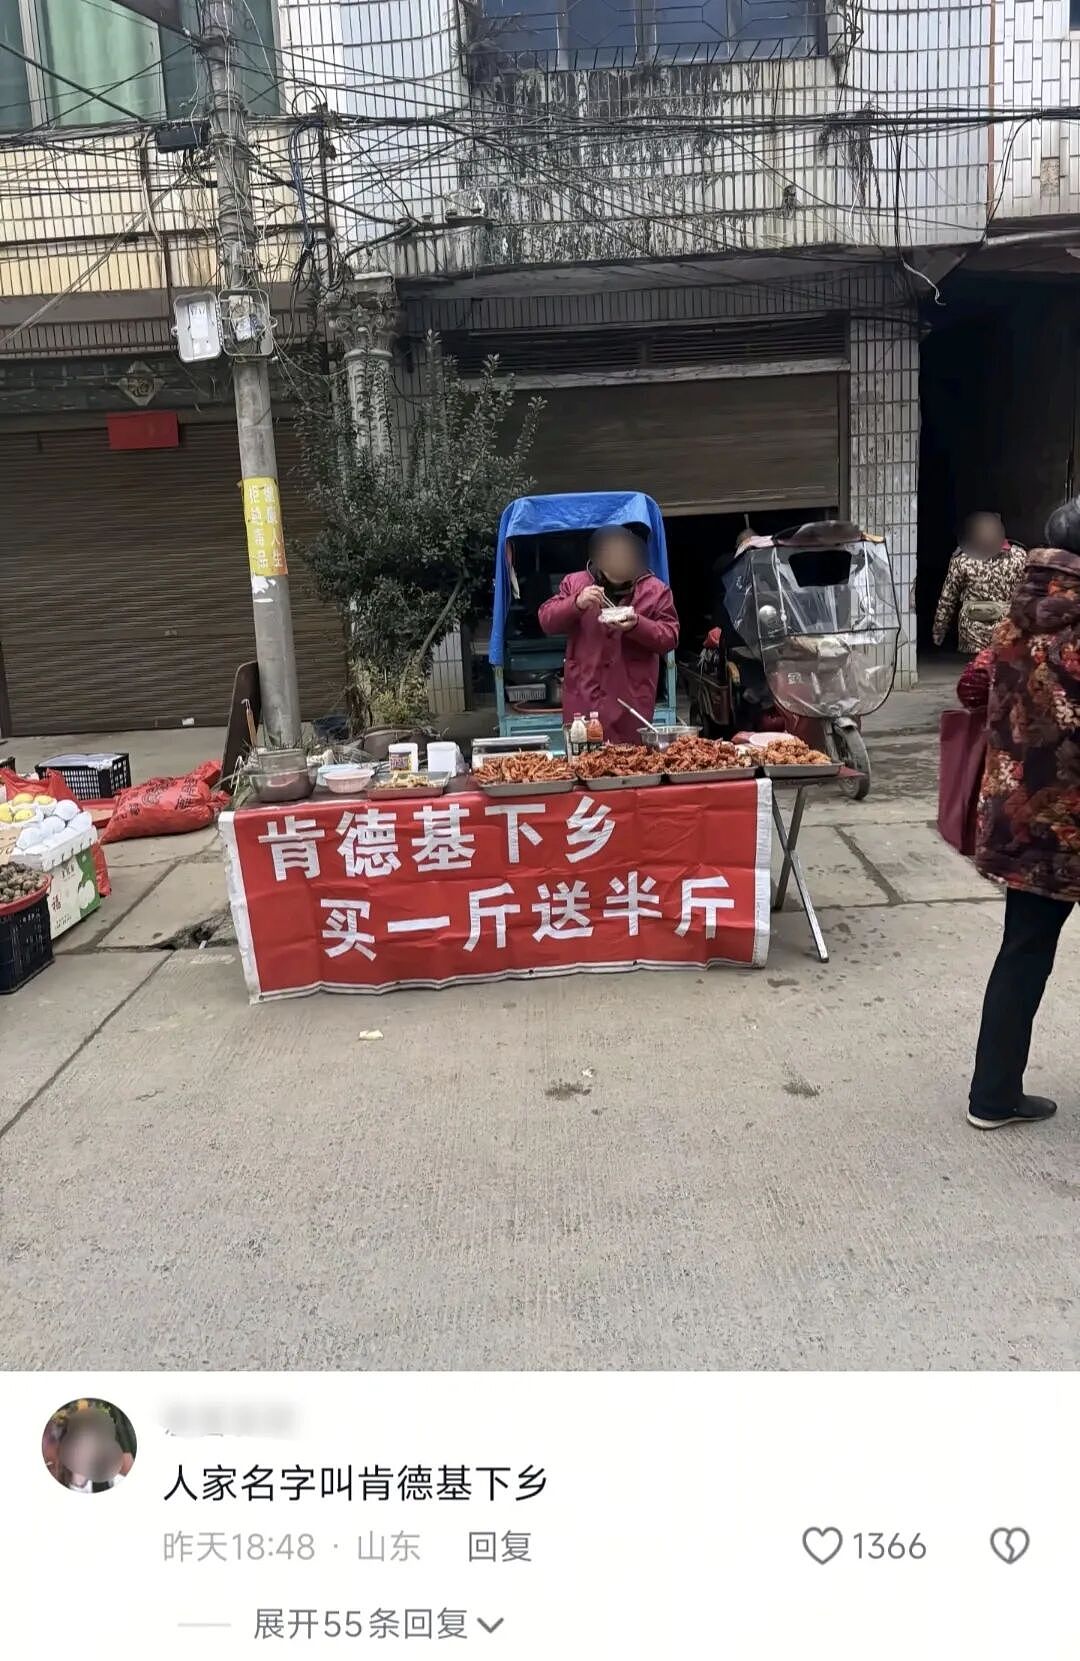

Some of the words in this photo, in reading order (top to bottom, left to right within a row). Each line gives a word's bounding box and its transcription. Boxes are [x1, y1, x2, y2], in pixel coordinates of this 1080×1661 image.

[257, 795, 616, 882] 肯德基下乡
[320, 871, 735, 961] 买一斤送半斤
